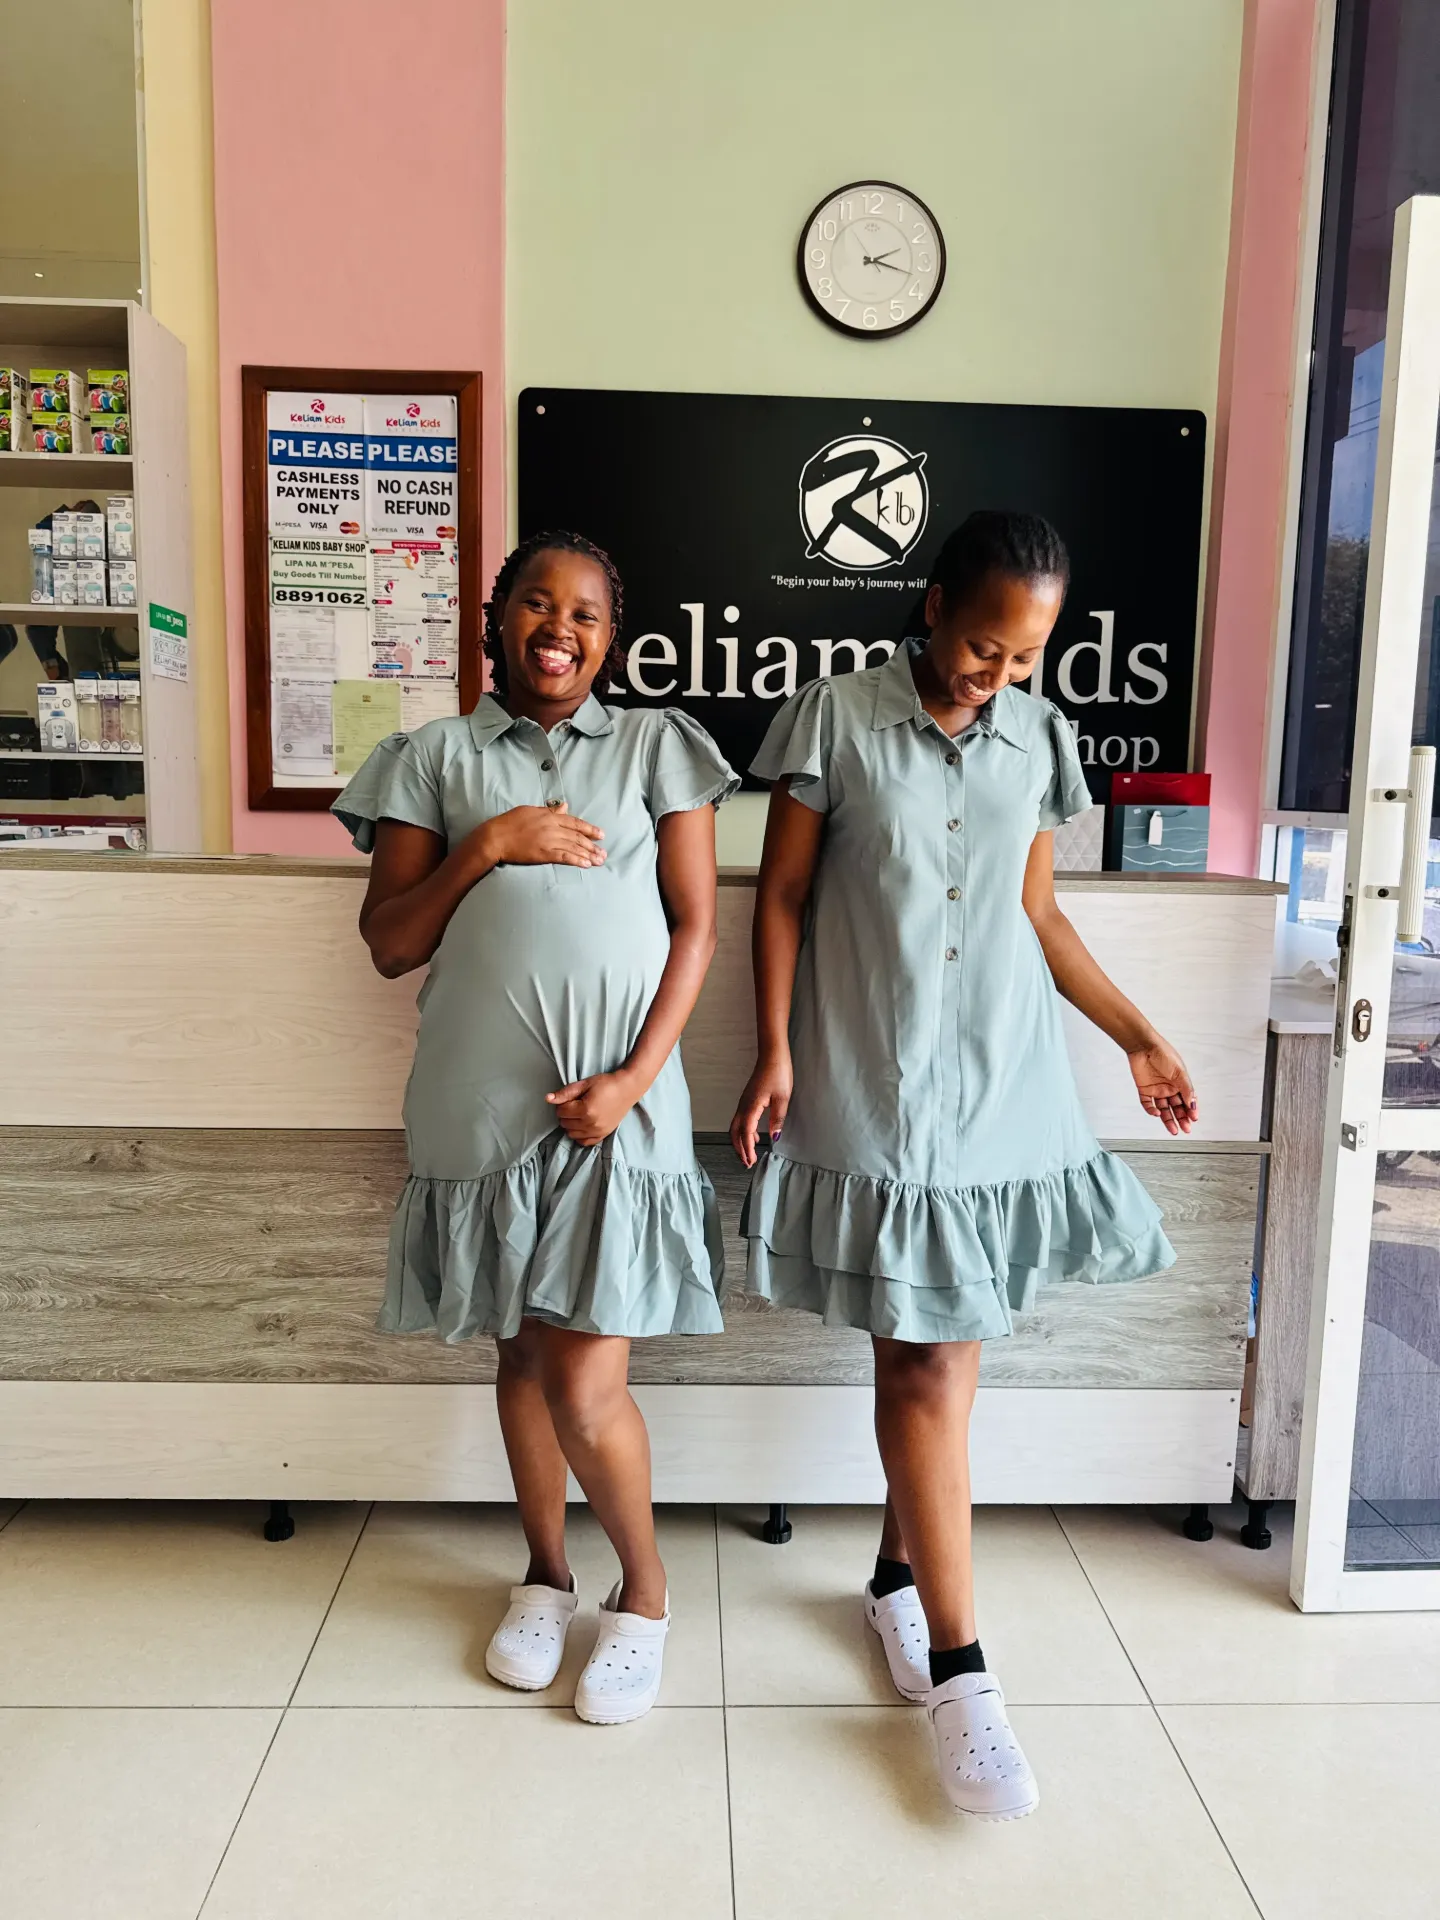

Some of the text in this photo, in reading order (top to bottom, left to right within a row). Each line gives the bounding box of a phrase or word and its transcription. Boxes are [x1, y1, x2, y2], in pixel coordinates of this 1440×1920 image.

[838, 200, 852, 220] 11
[861, 193, 884, 215] 12
[896, 202, 904, 222] 1
[817, 219, 837, 241] 10
[912, 222, 927, 244] 2
[810, 248, 826, 269] 9
[917, 251, 931, 272] 3
[817, 277, 832, 298] 8
[908, 279, 924, 300] 4
[836, 298, 851, 319] 7
[862, 306, 878, 328] 6
[889, 300, 905, 320] 5
[324, 415, 345, 424] Kids
[420, 419, 441, 428] Kids
[272, 438, 364, 460] PLEASE
[368, 443, 457, 464] PLEASE
[277, 470, 359, 485] CASHLESS
[377, 479, 453, 496] NO CASH
[276, 486, 360, 501] PAYMENTS
[297, 502, 340, 515] ONLY
[385, 500, 451, 516] REFUND
[309, 521, 328, 529] VISA
[406, 526, 424, 534] VISA
[273, 540, 365, 553] KELIAM KIDS BABY SHOP
[305, 560, 317, 568] NA
[273, 570, 288, 578] Buy
[334, 573, 366, 581] Number
[807, 577, 830, 589] your
[832, 576, 864, 590] baby’s
[866, 577, 905, 591] journey
[275, 590, 366, 604] 8891062
[608, 602, 898, 700] eliam
[1070, 720, 1161, 773] hop
